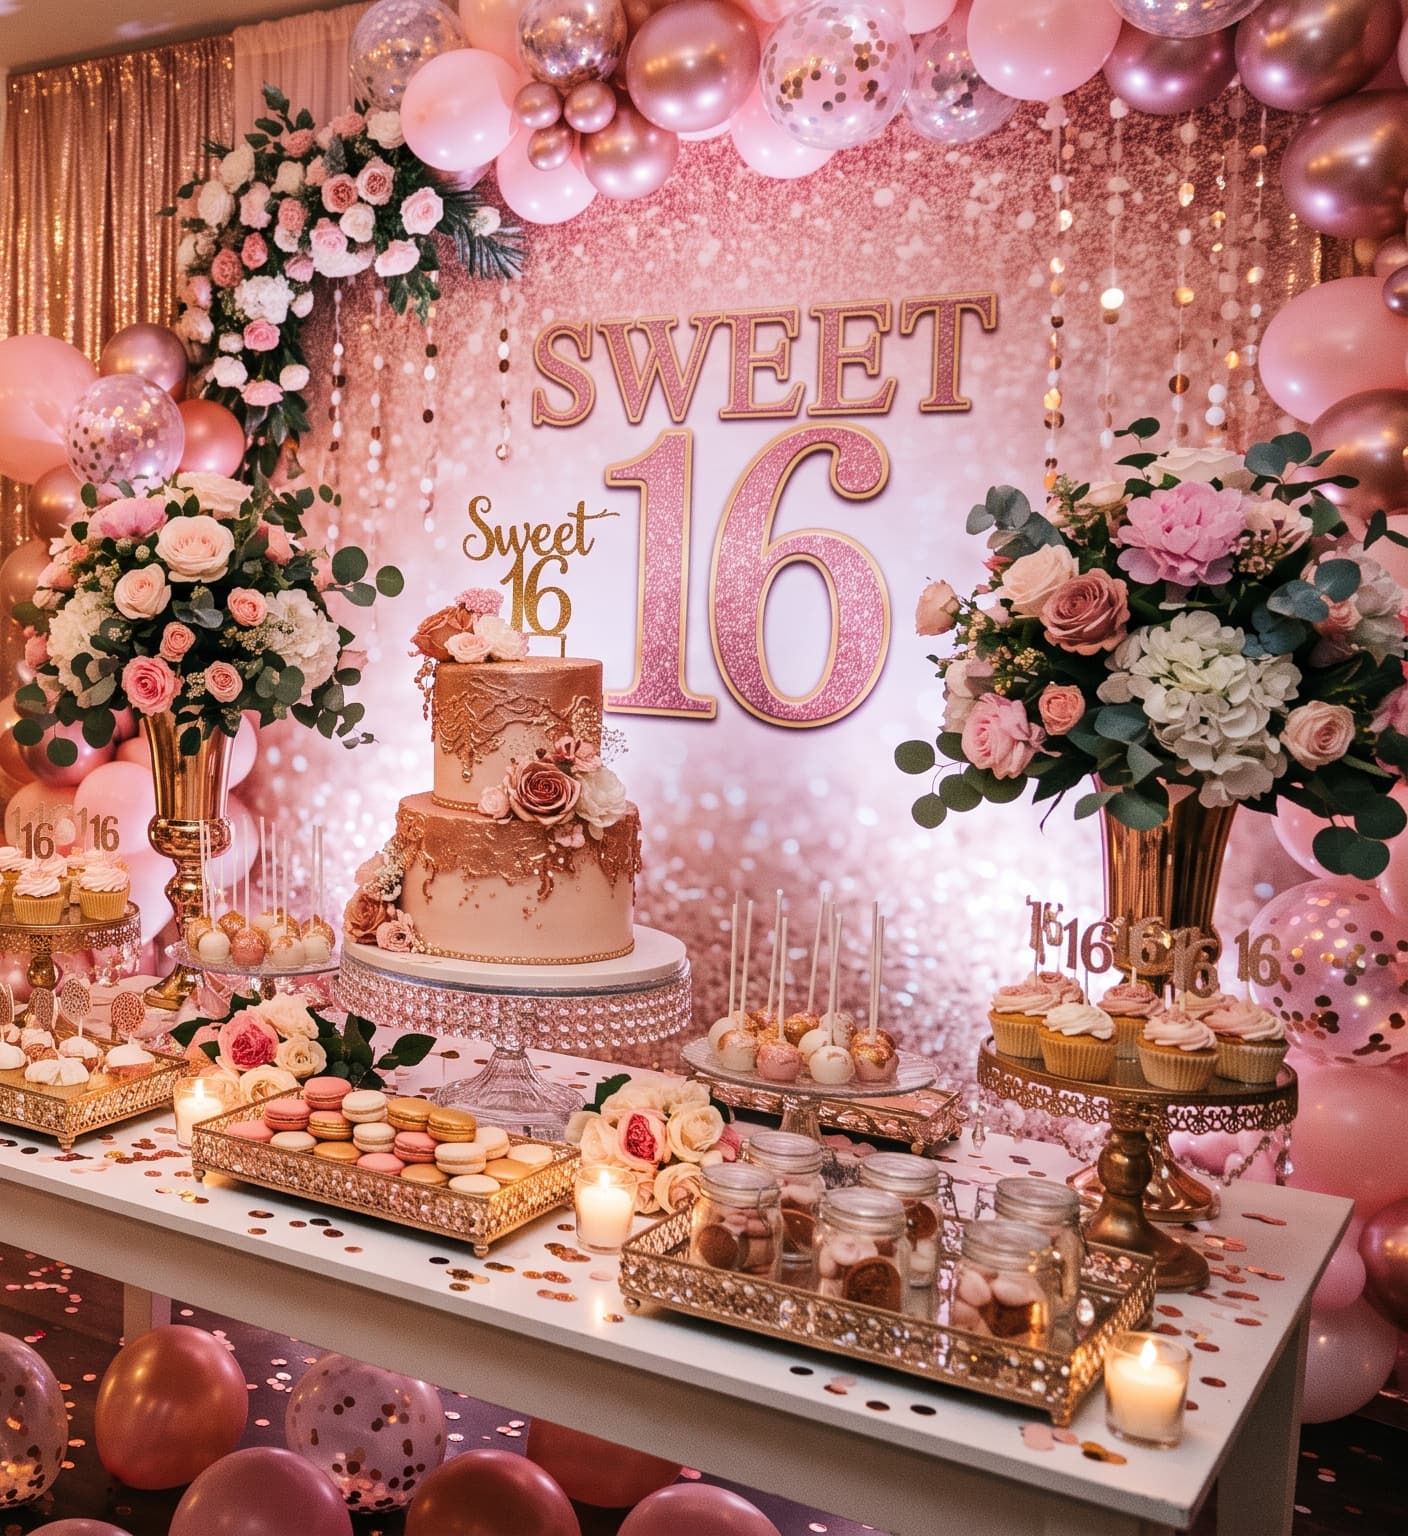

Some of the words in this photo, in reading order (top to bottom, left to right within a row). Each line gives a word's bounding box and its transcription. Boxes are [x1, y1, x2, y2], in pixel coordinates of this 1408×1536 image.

[532, 291, 997, 427] SWEET
[462, 495, 620, 561] Sweet
[500, 554, 572, 637] 16
[603, 421, 890, 728] 16
[20, 822, 55, 860] 16
[90, 814, 120, 852] 16
[1064, 917, 1116, 974] 16
[1234, 928, 1282, 987] 16
